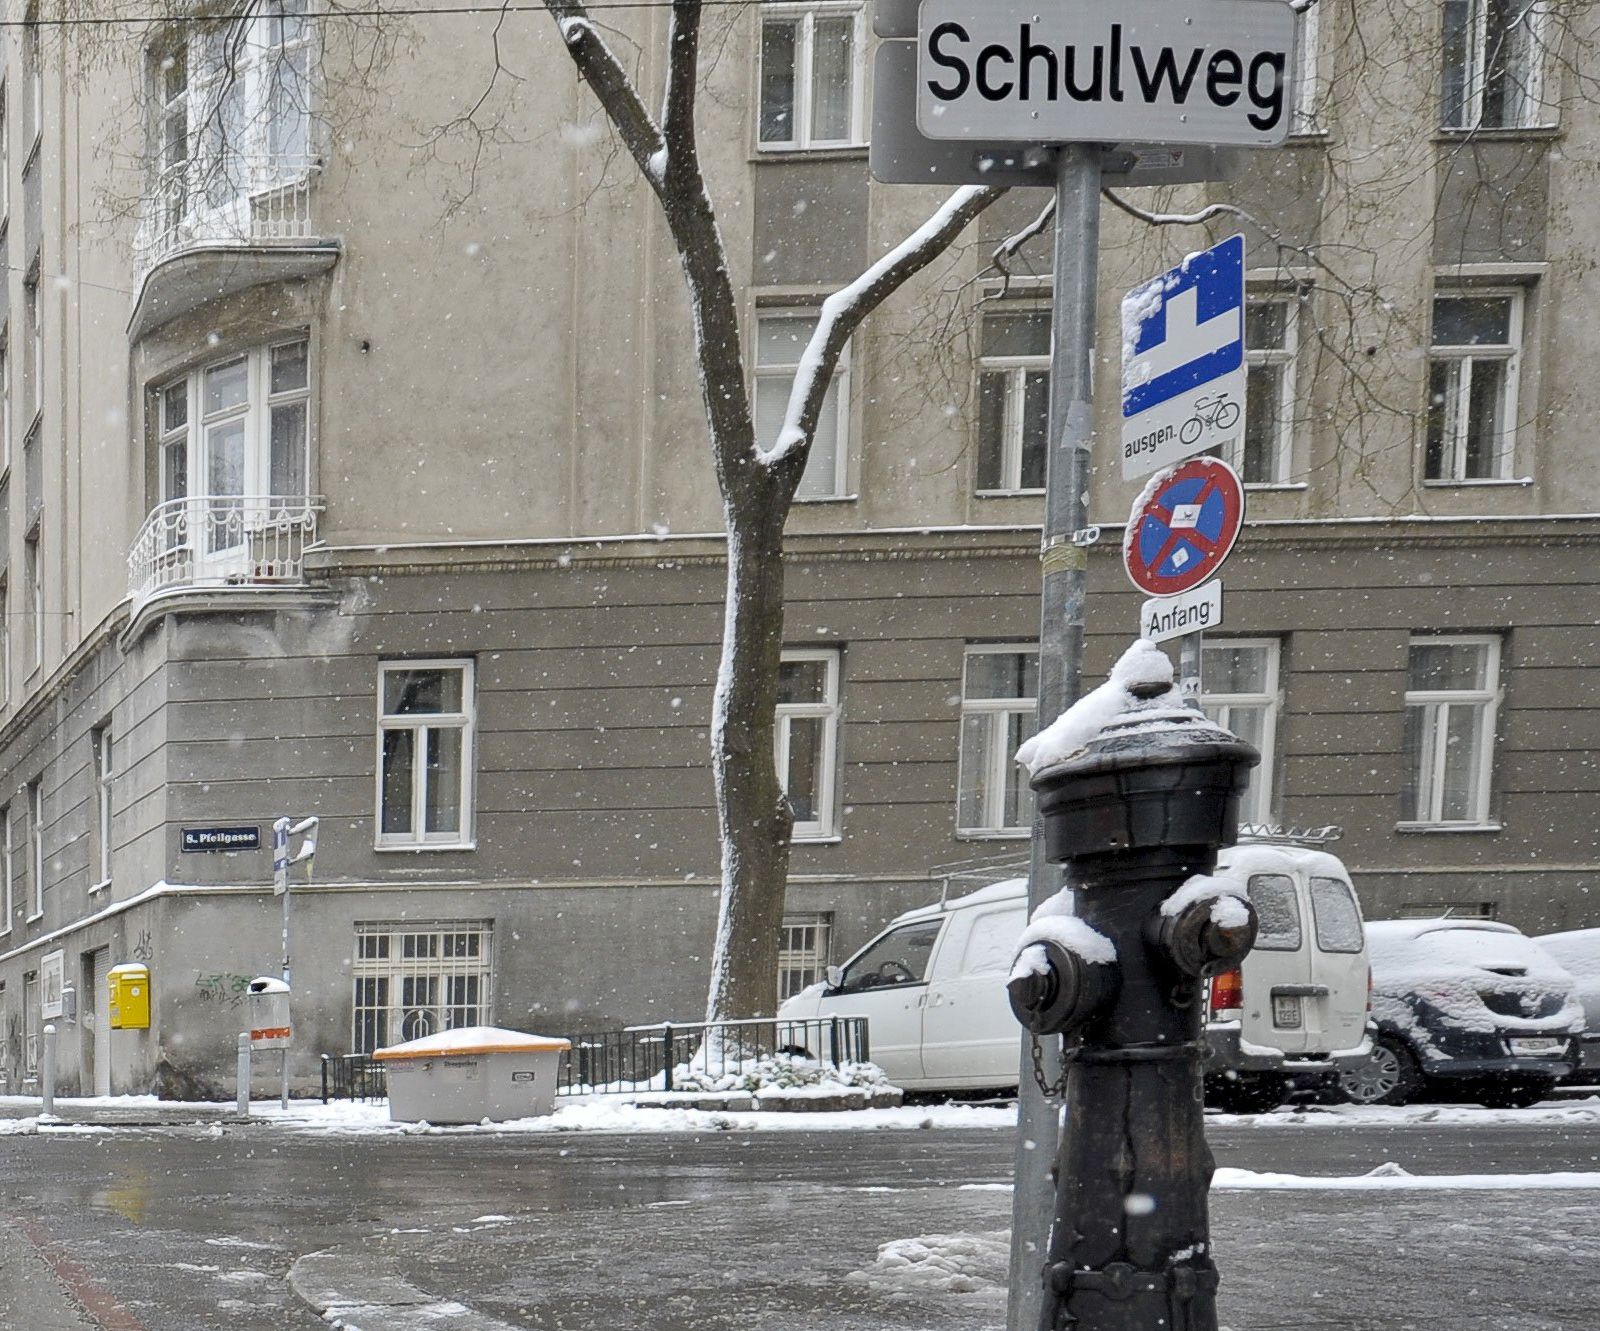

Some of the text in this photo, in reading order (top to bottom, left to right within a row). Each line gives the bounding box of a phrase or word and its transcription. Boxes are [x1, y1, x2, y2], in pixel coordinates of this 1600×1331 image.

[927, 21, 1286, 131] Schulweg
[1124, 424, 1177, 458] ausgen.
[1148, 601, 1210, 636] Anfang
[199, 832, 257, 843] Pfeilgasse
